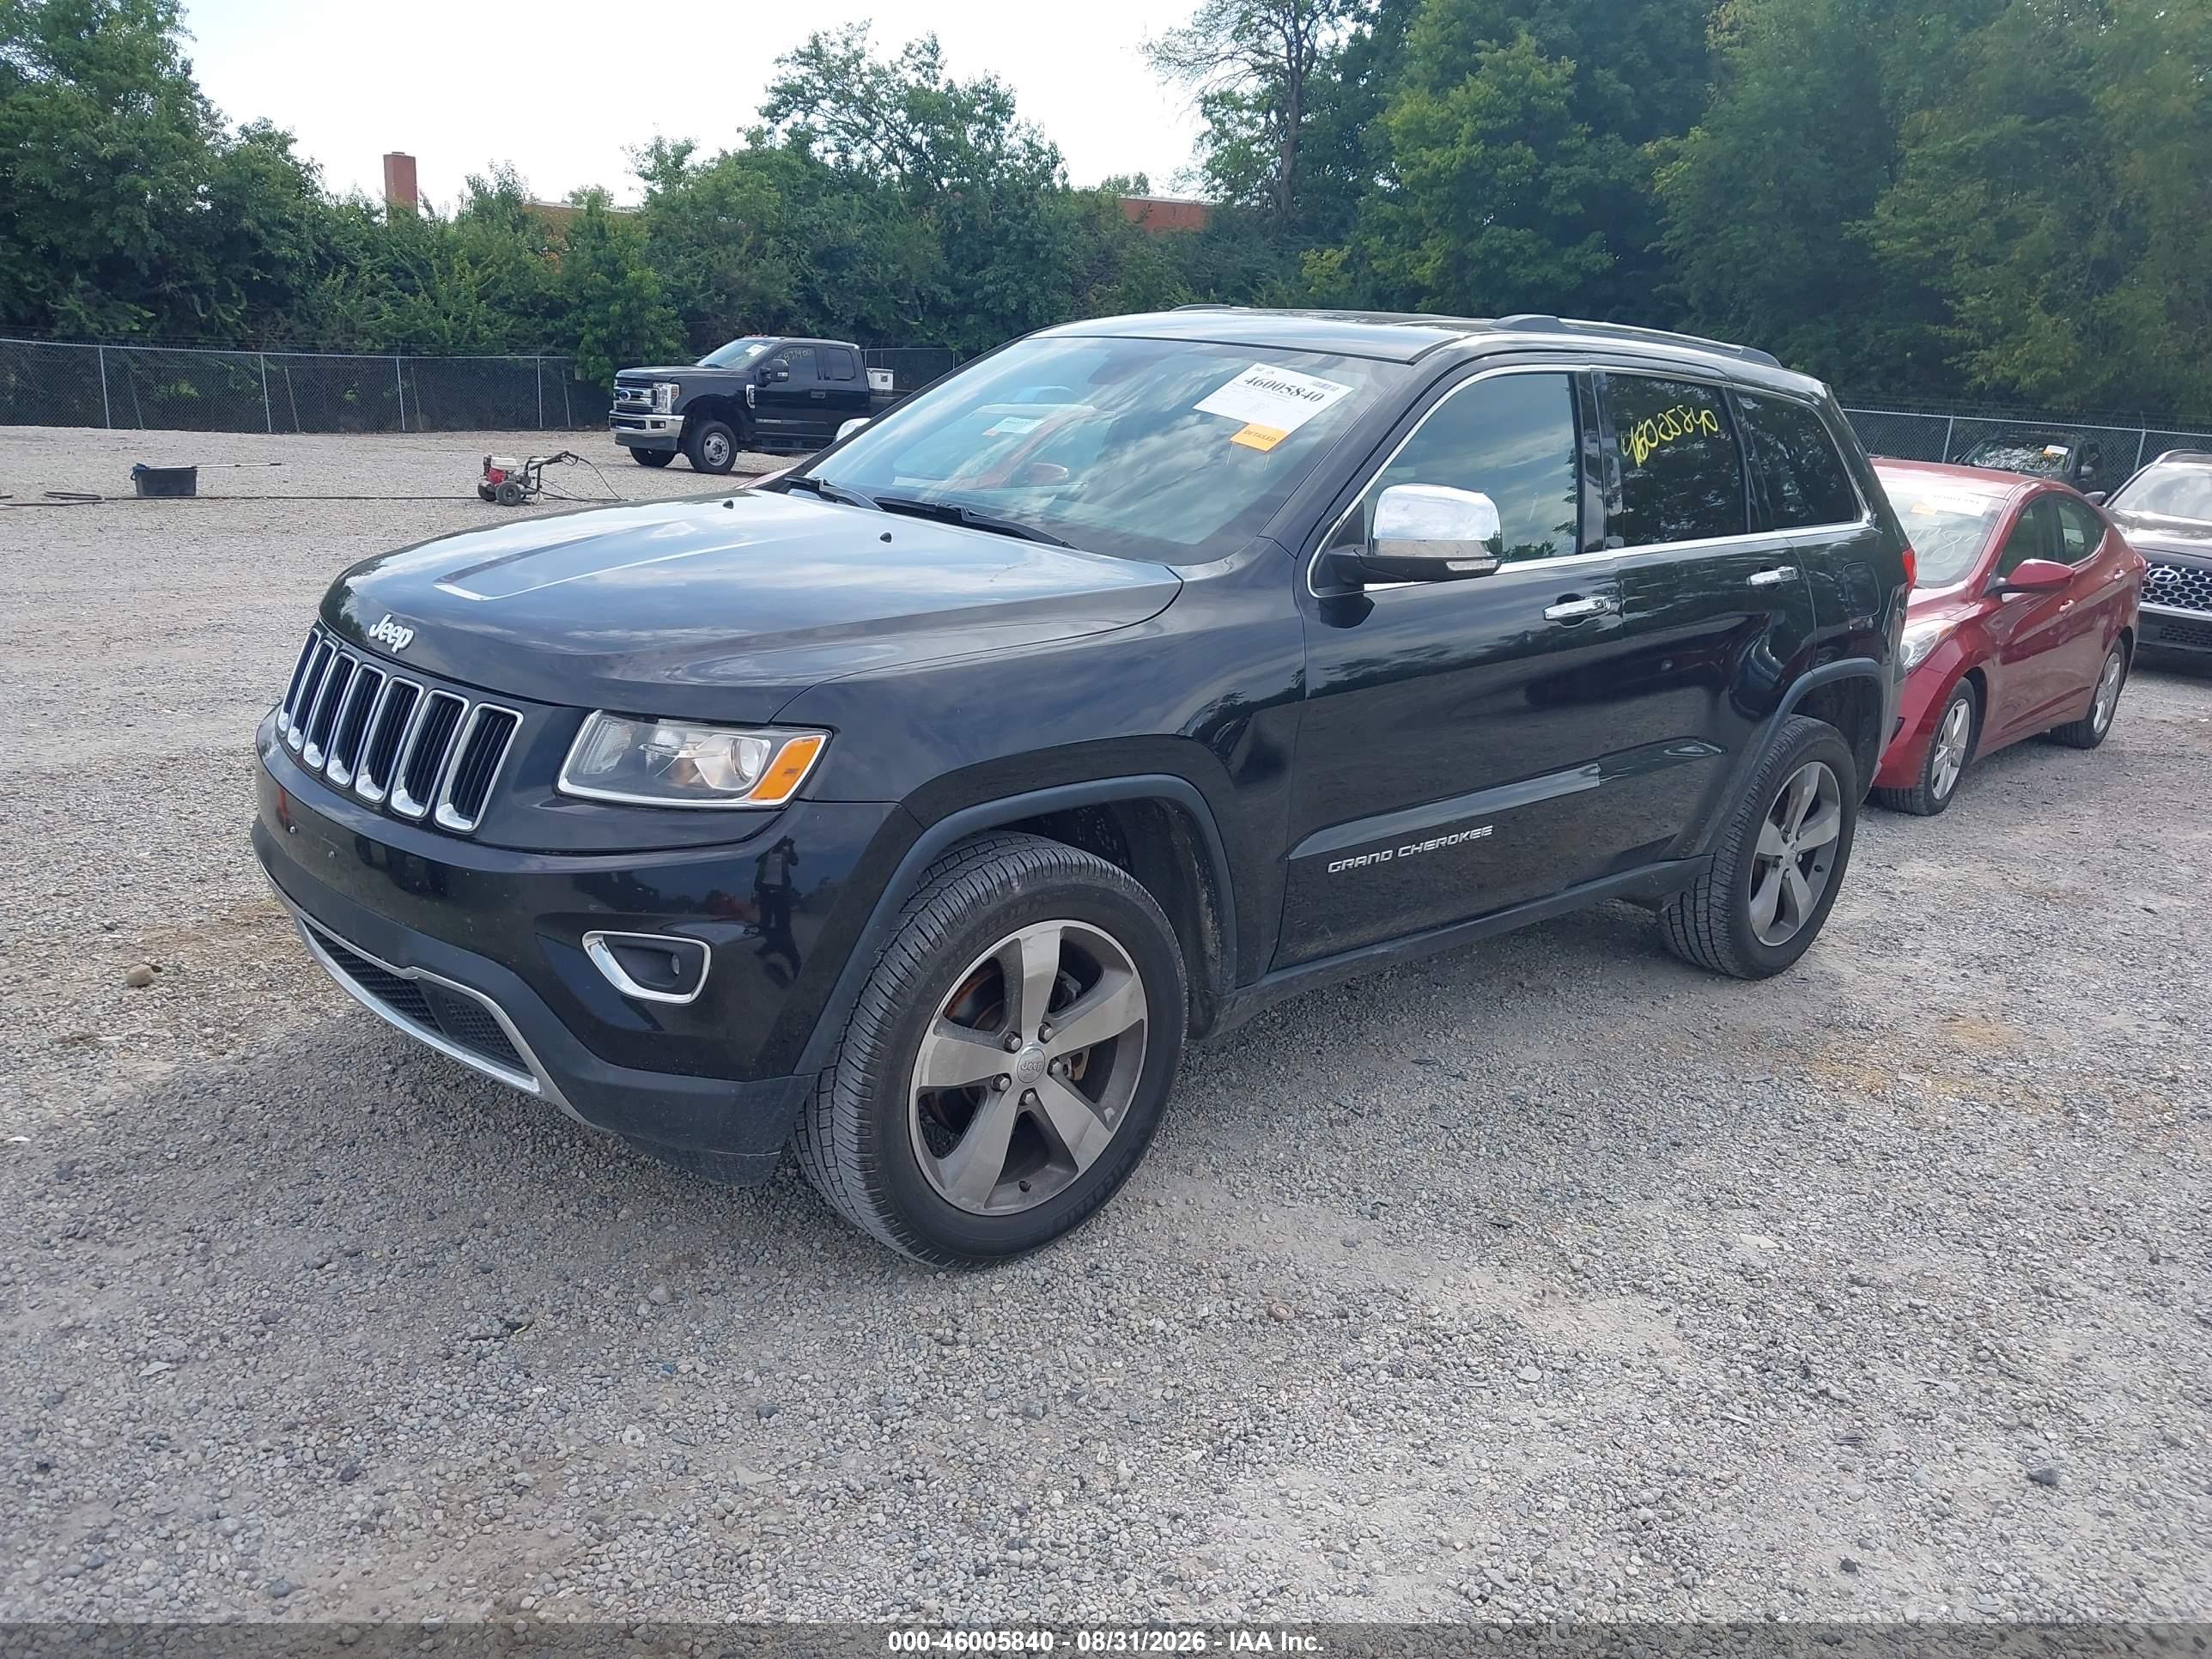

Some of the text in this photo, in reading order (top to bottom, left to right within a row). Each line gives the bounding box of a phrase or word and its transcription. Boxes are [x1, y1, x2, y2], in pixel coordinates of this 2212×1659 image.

[1243, 376, 1325, 403] 46005840
[369, 614, 414, 653] Jeep
[1328, 824, 1493, 873] GRAND CHEROKEE
